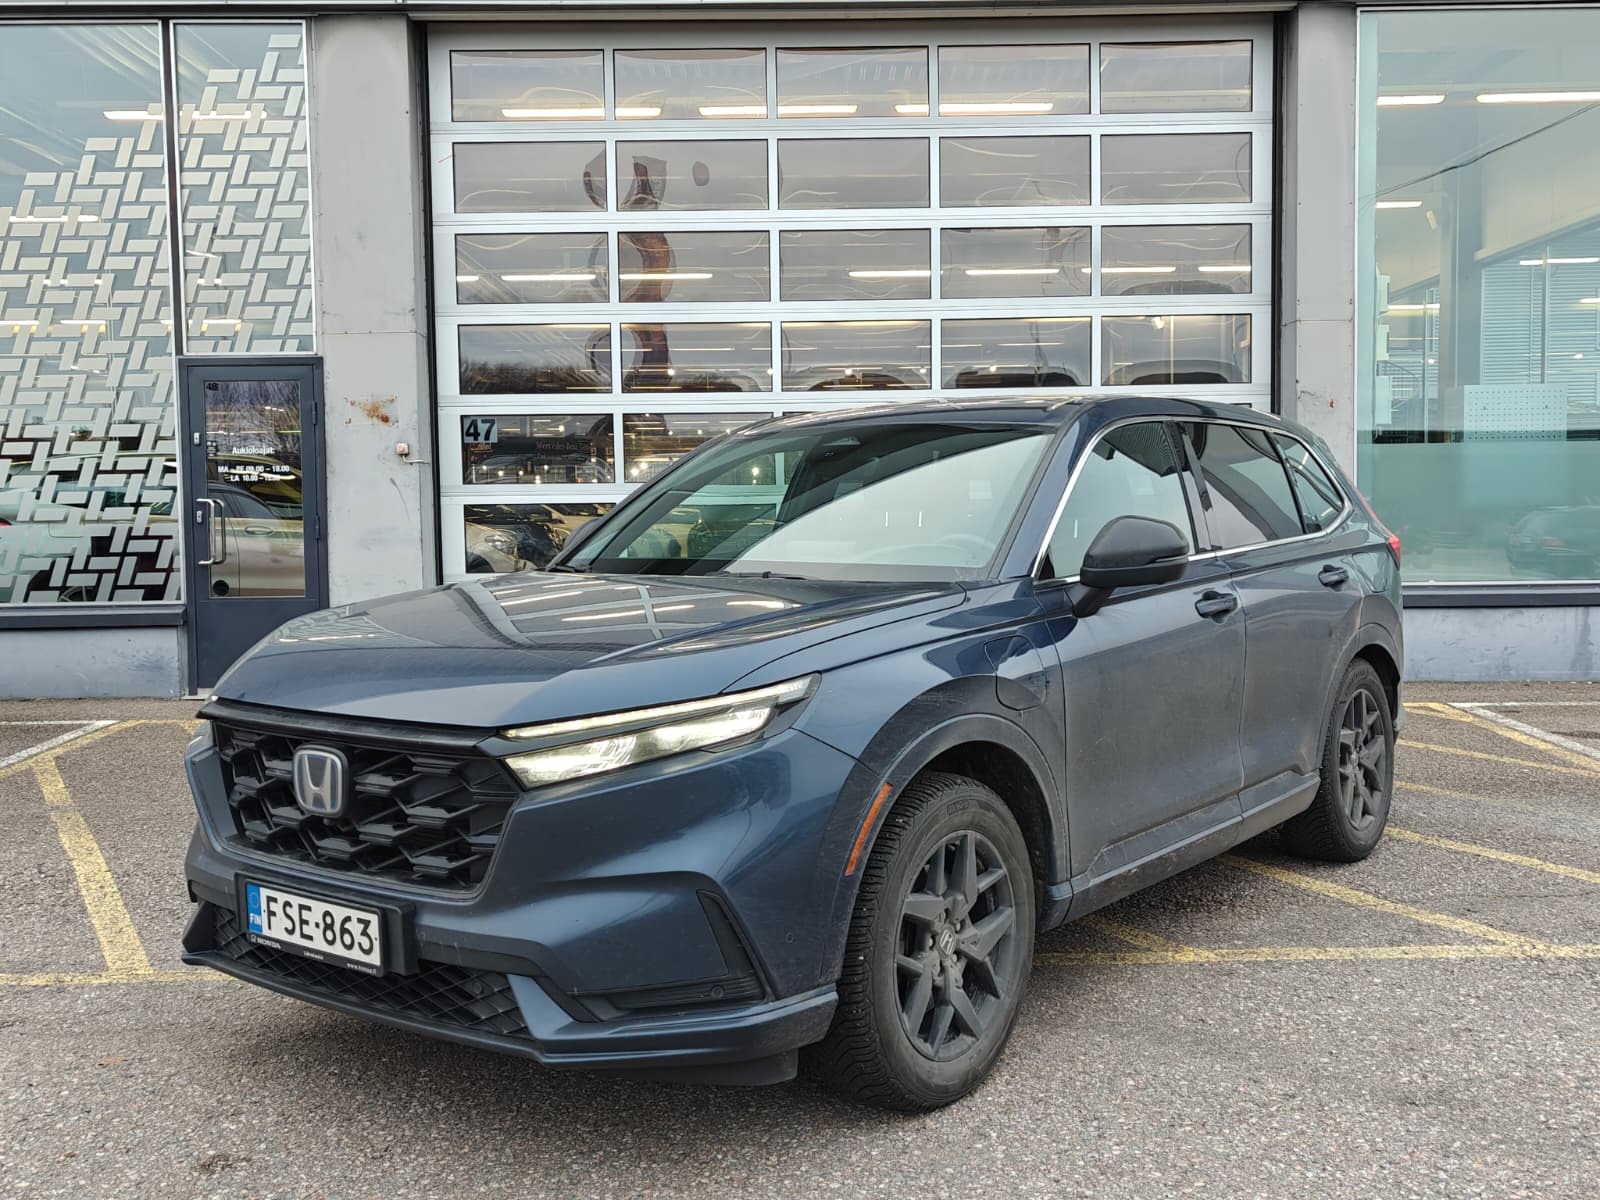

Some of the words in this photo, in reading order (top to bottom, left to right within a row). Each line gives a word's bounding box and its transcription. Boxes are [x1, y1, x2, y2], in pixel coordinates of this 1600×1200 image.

[206, 383, 218, 391] 48
[465, 418, 496, 442] 47
[232, 444, 275, 455] Aukioloajat:
[249, 913, 261, 925] FIN
[265, 895, 374, 956] FSE-863
[257, 937, 281, 949] HONDA
